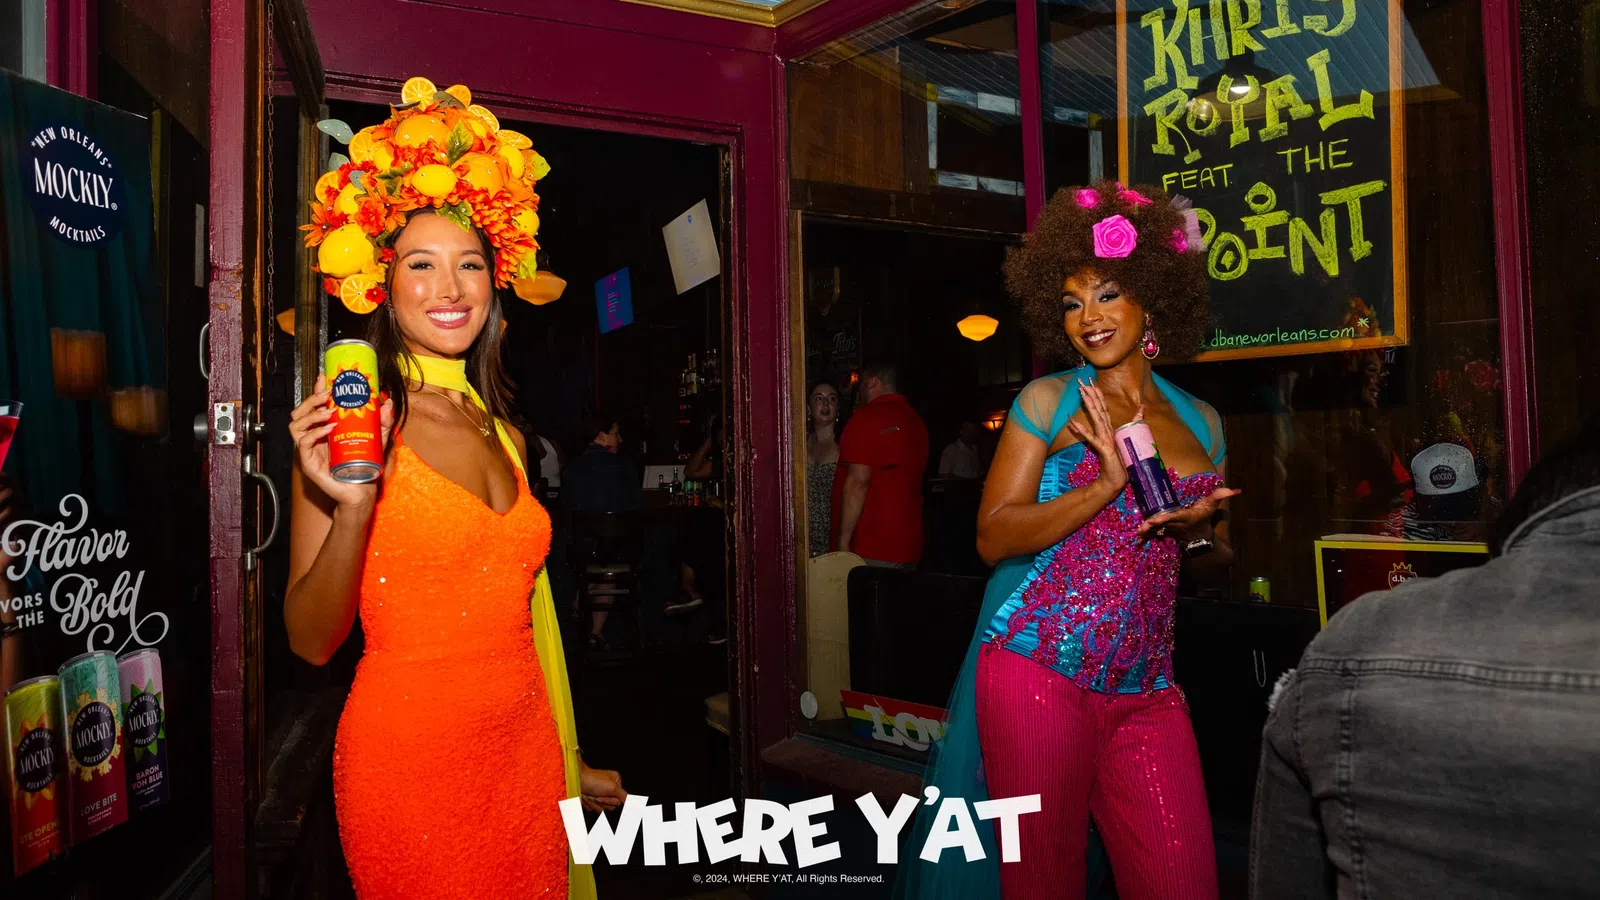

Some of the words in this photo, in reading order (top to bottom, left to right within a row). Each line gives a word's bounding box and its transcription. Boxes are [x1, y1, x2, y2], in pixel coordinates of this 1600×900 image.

[1143, 49, 1375, 164] ROYAL
[35, 126, 56, 149] NEW
[61, 126, 108, 166] ORLEANS
[1277, 139, 1353, 174] THE
[49, 216, 106, 243] MOCKTAILS
[1211, 326, 1355, 348] dbaneworleans.com
[346, 431, 374, 440] OPENER
[1, 493, 130, 582] Flavor
[16, 610, 45, 629] THE
[50, 570, 169, 648] Bold
[131, 777, 148, 790] VON
[148, 770, 164, 784] BLUE
[135, 764, 160, 780] BARON
[80, 800, 102, 817] LOVE
[102, 792, 119, 807] BITE
